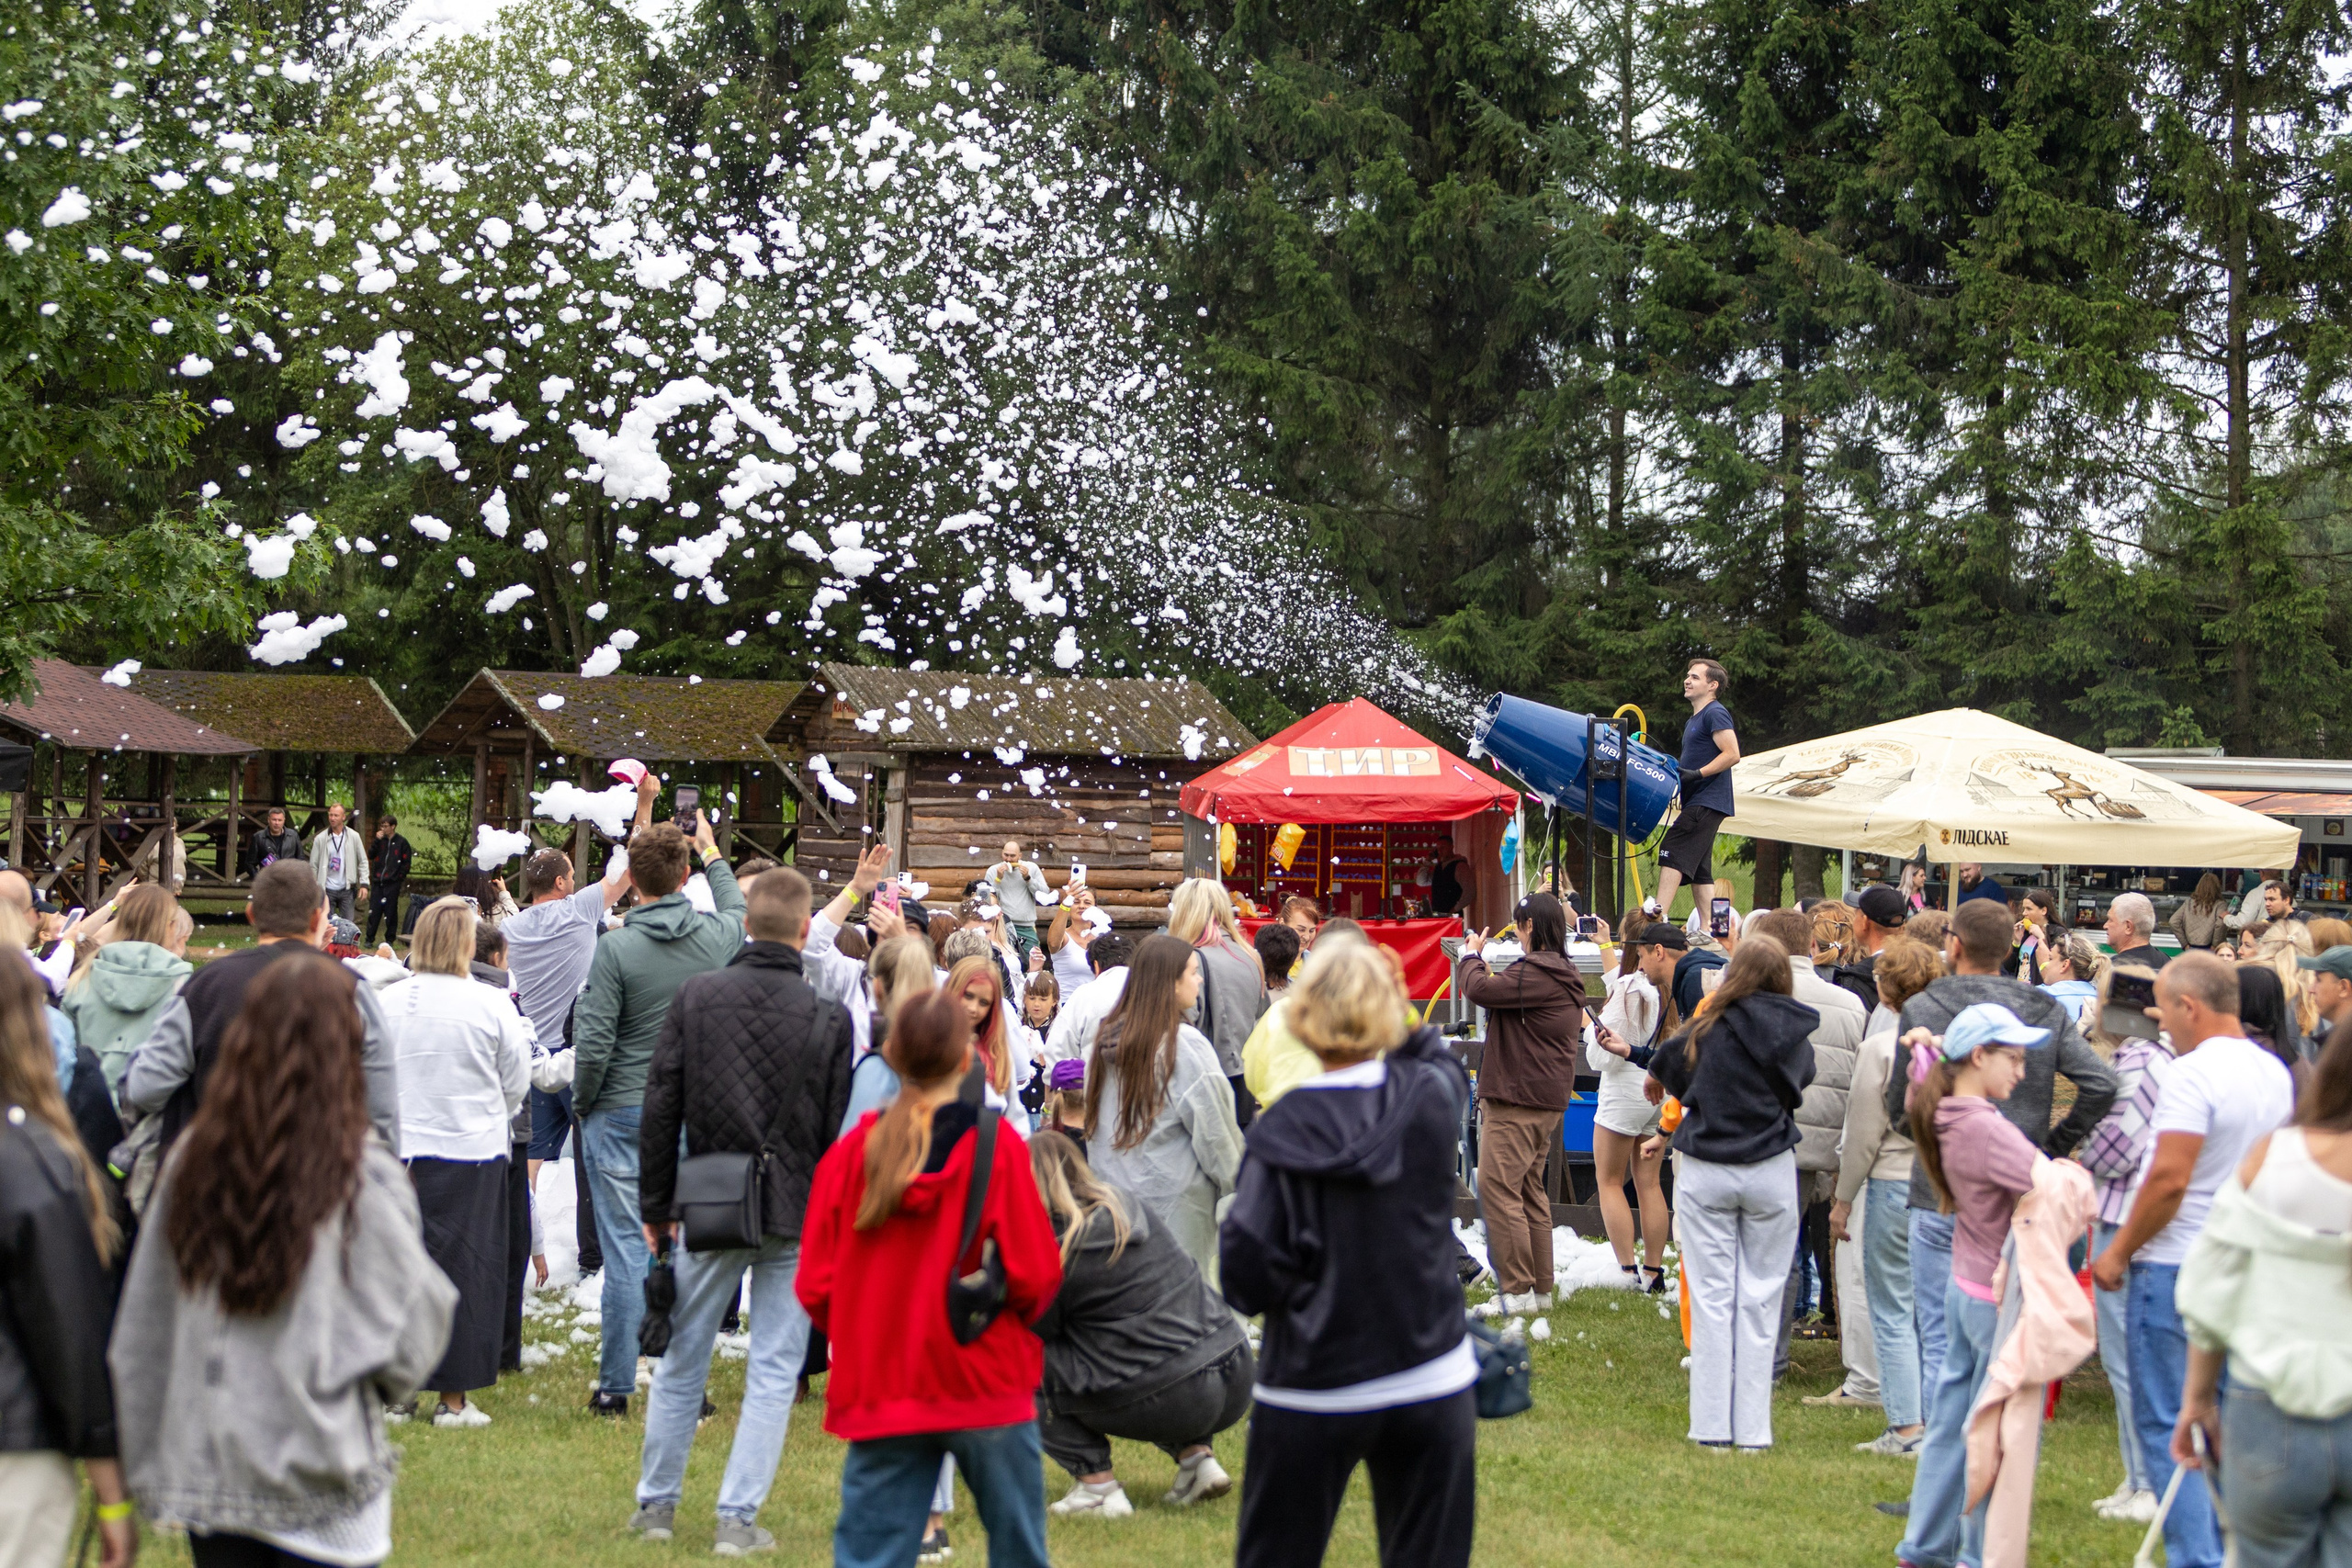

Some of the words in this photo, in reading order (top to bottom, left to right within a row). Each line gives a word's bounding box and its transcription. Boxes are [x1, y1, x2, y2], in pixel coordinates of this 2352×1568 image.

[1295, 748, 1431, 775] ТИР
[1626, 758, 1666, 782] FC-500
[2016, 771, 2038, 780] 18
[2077, 774, 2101, 783] 76
[1953, 829, 2009, 847] ЛІДСКАЕ
